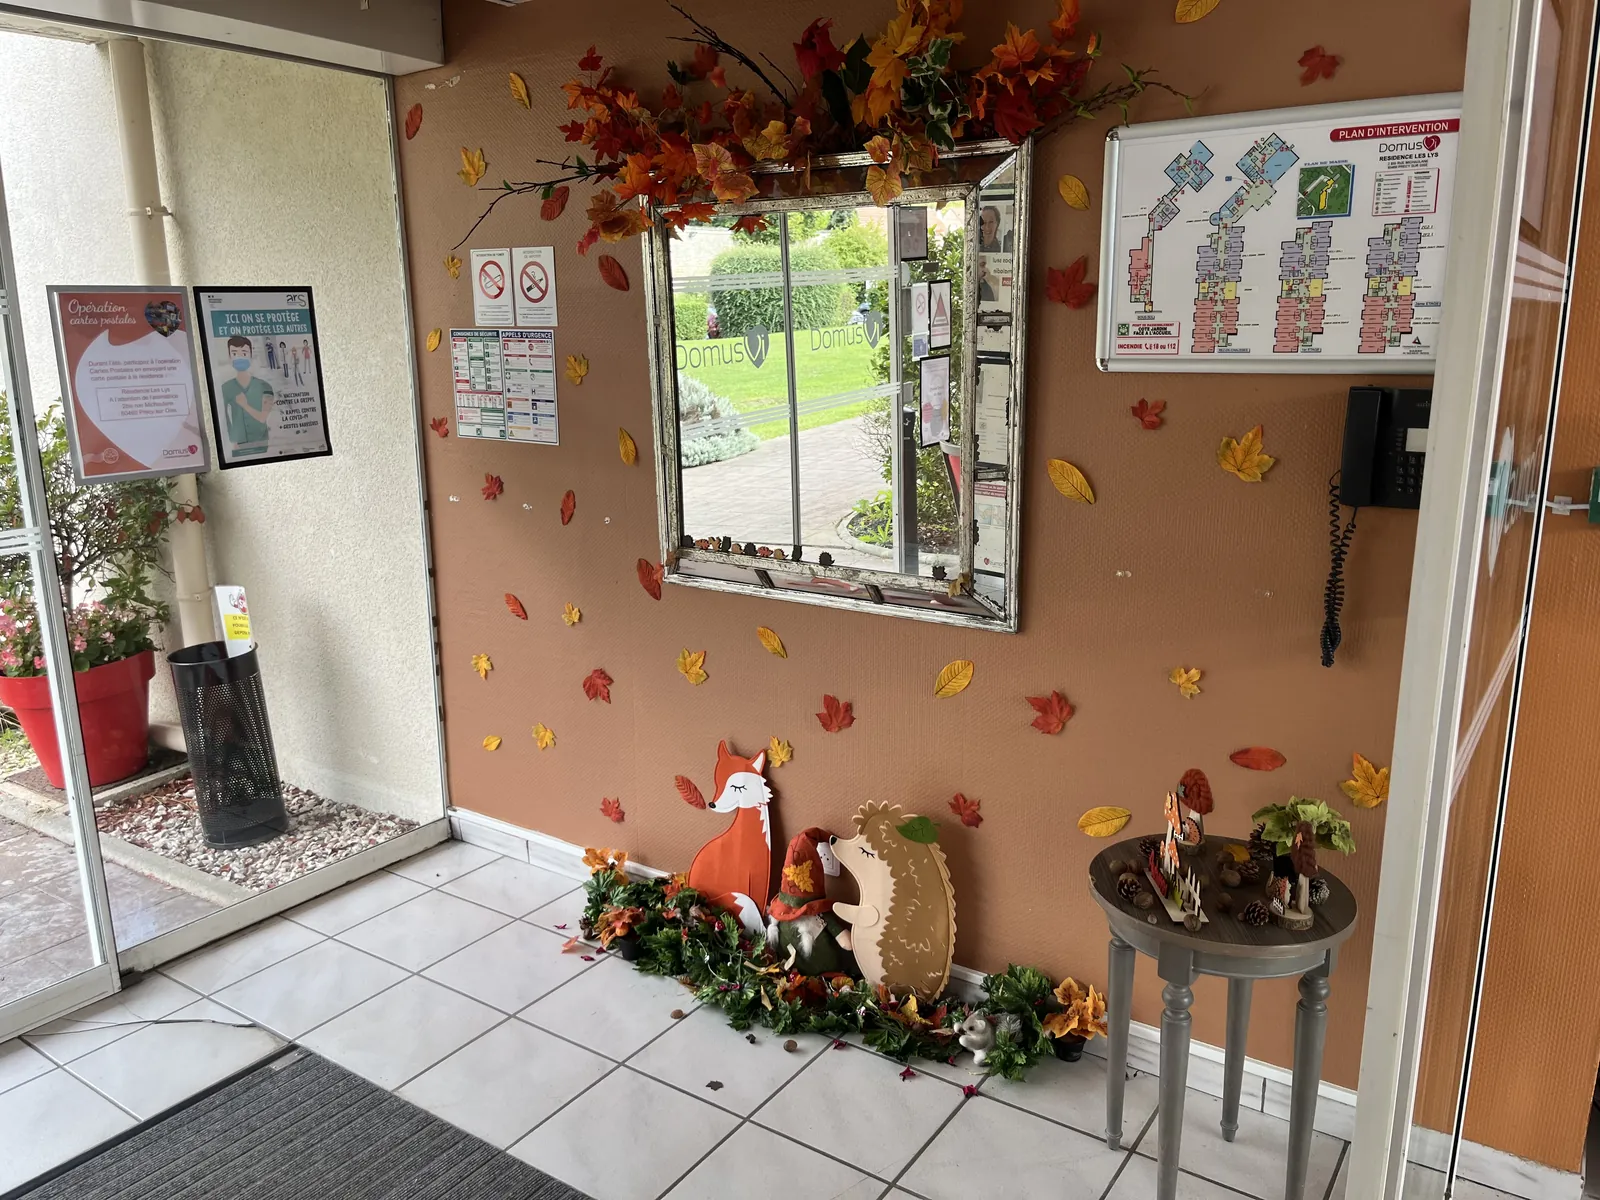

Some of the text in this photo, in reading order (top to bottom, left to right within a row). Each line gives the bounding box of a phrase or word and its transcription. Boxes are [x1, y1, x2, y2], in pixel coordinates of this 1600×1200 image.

[1339, 121, 1449, 139] PLAN D'INTERVENTION
[68, 299, 128, 316] Opération
[69, 313, 136, 327] cartes postales
[225, 310, 300, 324] ICI ON SE PROTÈGE
[218, 323, 308, 335] ET ON PROTÈGE LES AUTRES
